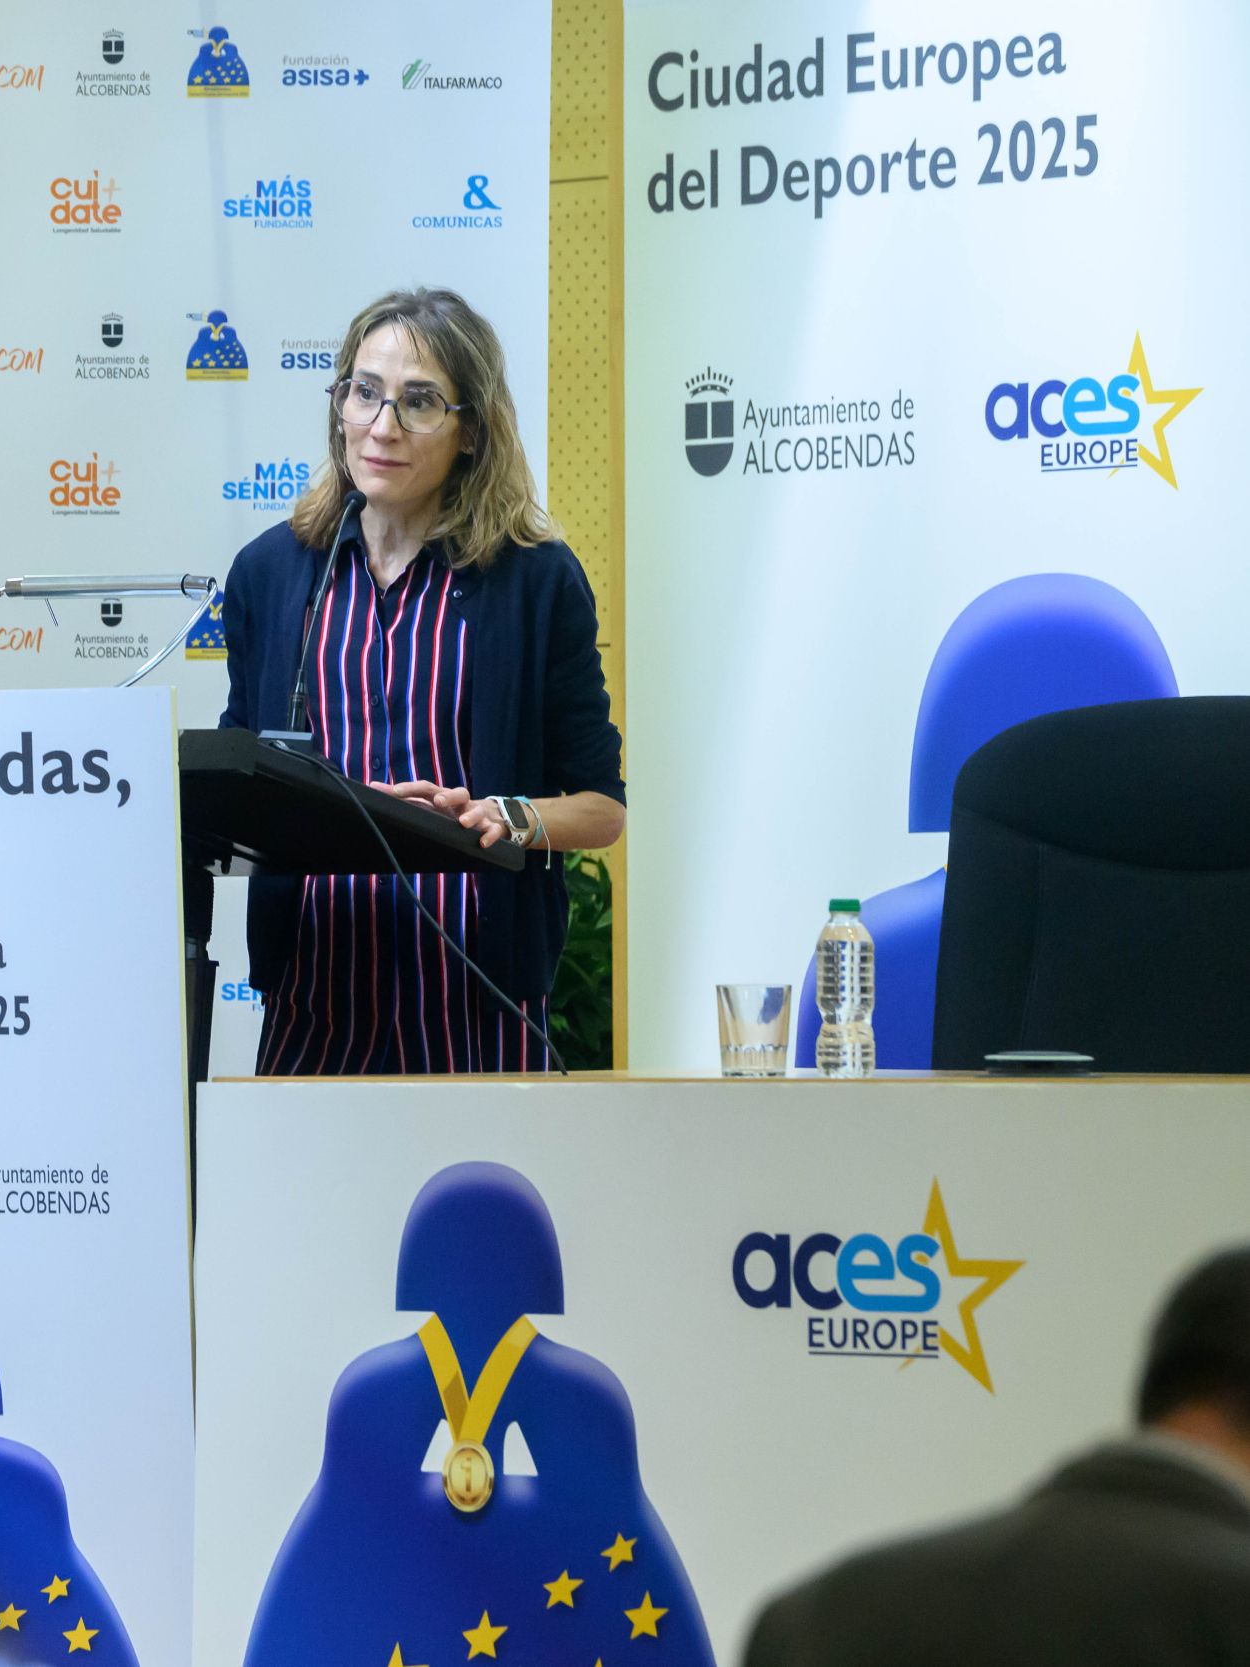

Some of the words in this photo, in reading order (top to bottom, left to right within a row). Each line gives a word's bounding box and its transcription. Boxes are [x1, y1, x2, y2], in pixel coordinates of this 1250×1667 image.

[282, 54, 350, 66] fundación
[648, 37, 825, 112] Ciudad
[846, 31, 1067, 102] Europea
[76, 71, 136, 84] Ayuntamiento
[139, 71, 150, 82] de
[424, 77, 503, 89] ITALFARMACO
[76, 84, 151, 97] ALCOBENDAS
[648, 149, 719, 214] del
[740, 137, 957, 219] Deporte
[977, 114, 1099, 185] 2025
[256, 174, 311, 198] MÁS
[463, 175, 502, 210] &
[223, 194, 312, 217] SÉNIOR
[412, 216, 503, 229] COMUNICAS
[75, 354, 135, 368] Ayuntamiento
[139, 354, 150, 365] de
[75, 367, 150, 379] ALCOBENDAS
[743, 396, 881, 437] Ayuntamiento
[891, 390, 915, 419] de
[985, 374, 1140, 441] aces
[743, 431, 915, 475] ALCOBENDAS
[1040, 438, 1139, 467] EUROPE
[255, 457, 310, 480] MÁS
[74, 633, 134, 646] Ayuntamiento
[138, 633, 149, 644] de
[74, 646, 149, 658] ALCOBENDAS
[91, 1163, 109, 1184] de
[732, 1231, 941, 1313] aces
[807, 1317, 940, 1351] EUROPE
